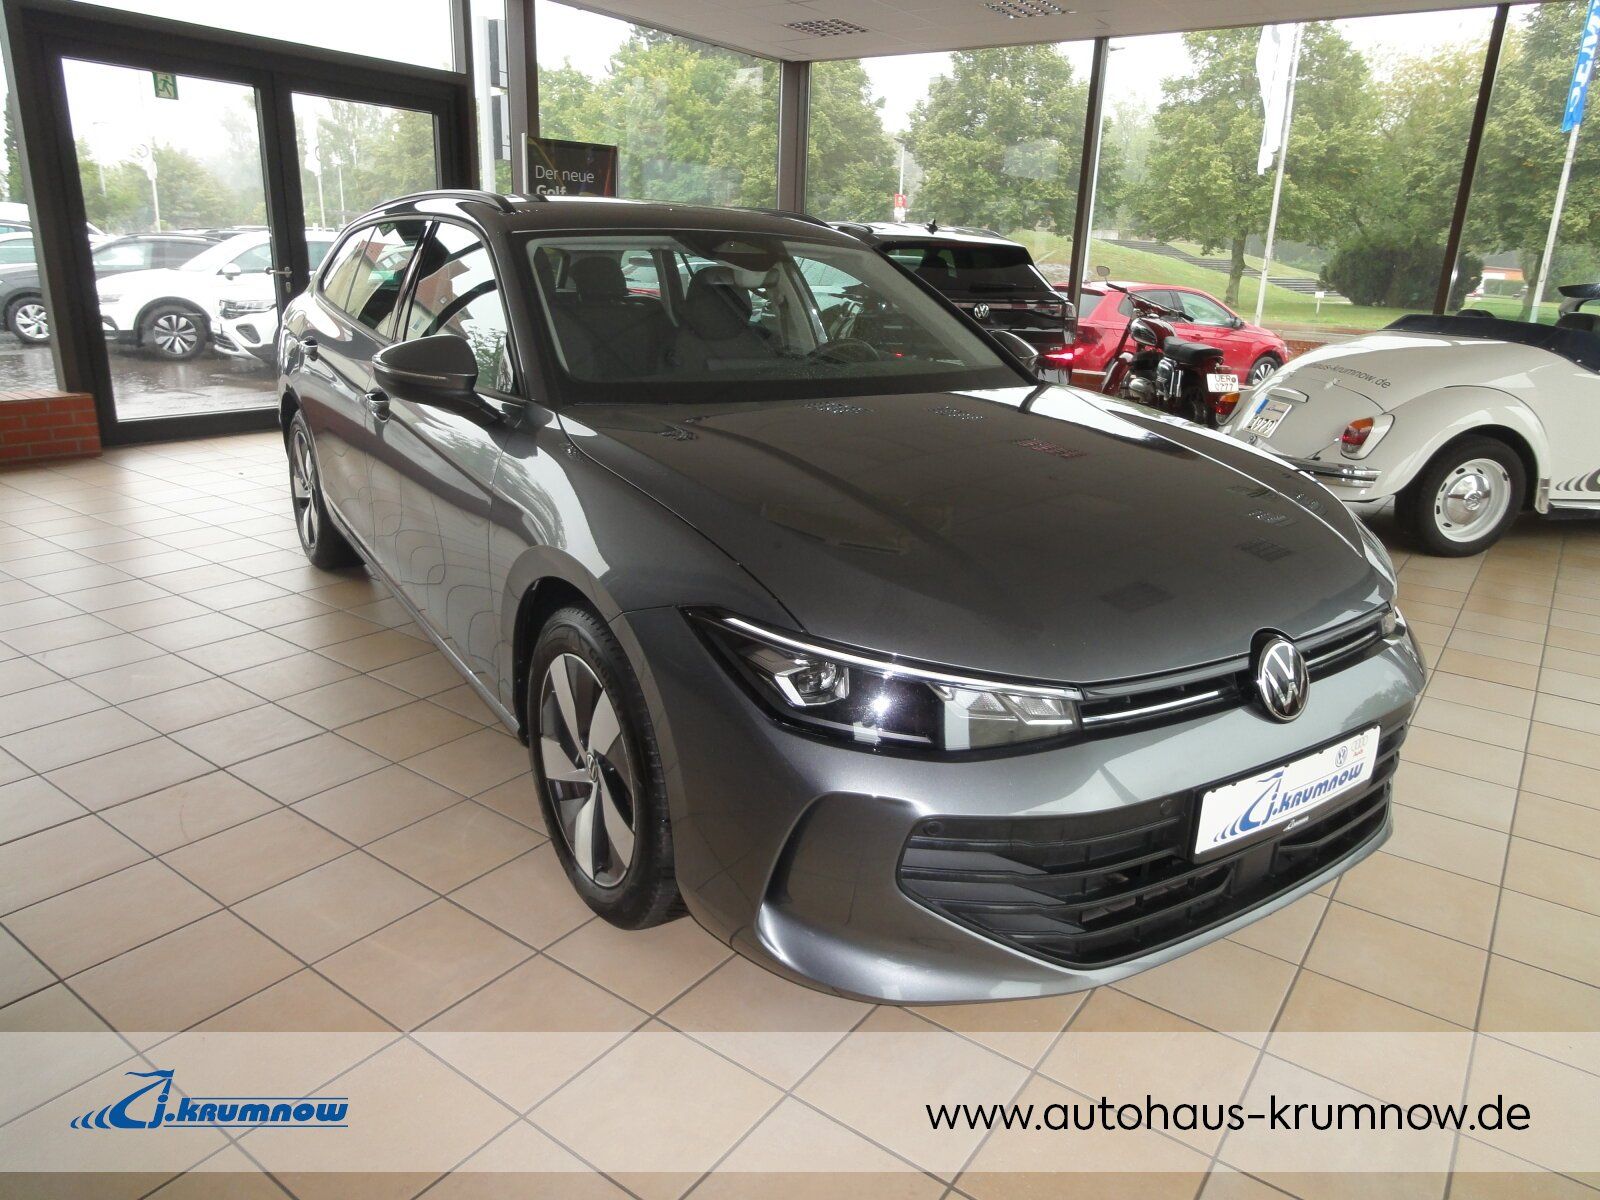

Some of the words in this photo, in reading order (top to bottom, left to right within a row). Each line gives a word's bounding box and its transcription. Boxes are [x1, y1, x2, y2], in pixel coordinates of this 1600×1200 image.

[535, 165, 558, 179] Der
[562, 170, 595, 183] neue
[536, 184, 567, 195] Golf
